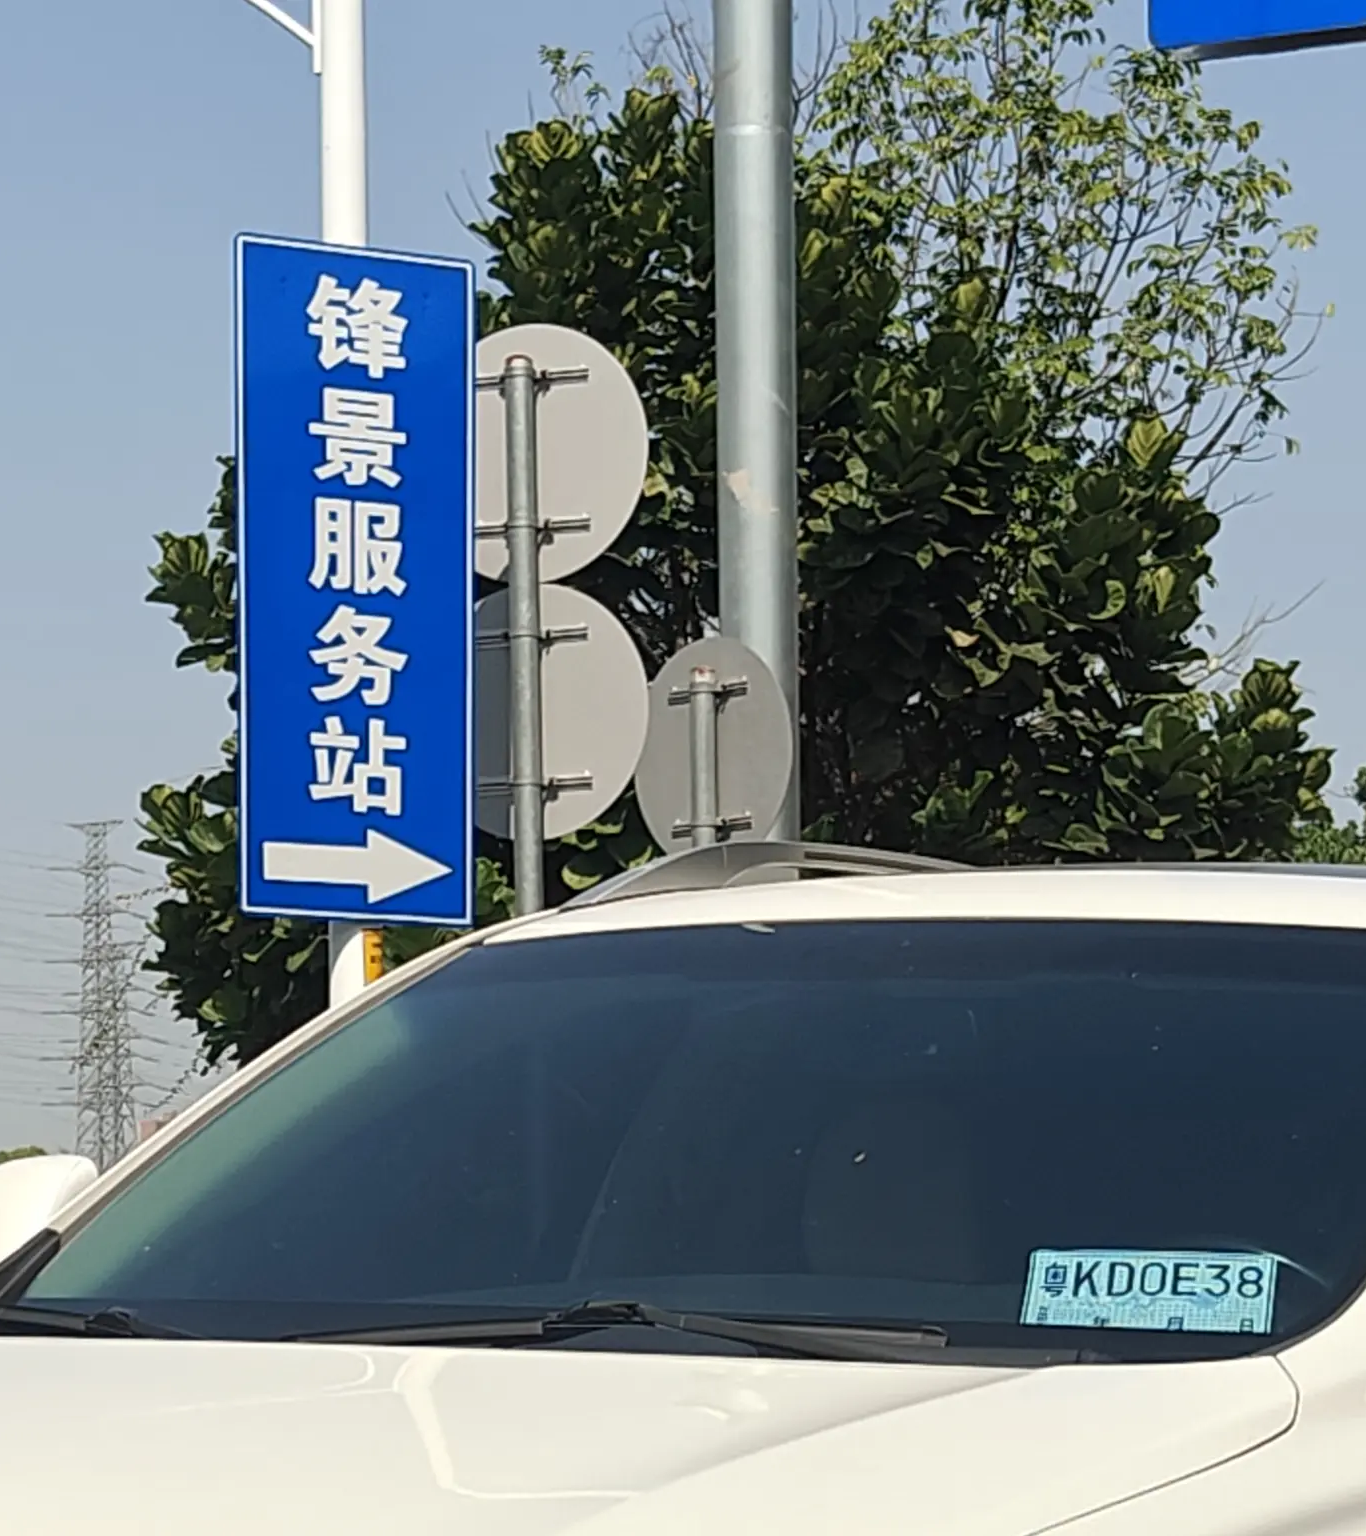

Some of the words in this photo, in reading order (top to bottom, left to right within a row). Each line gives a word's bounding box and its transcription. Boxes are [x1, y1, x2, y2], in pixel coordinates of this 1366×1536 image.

[305, 274, 409, 816] 锋景服务站
